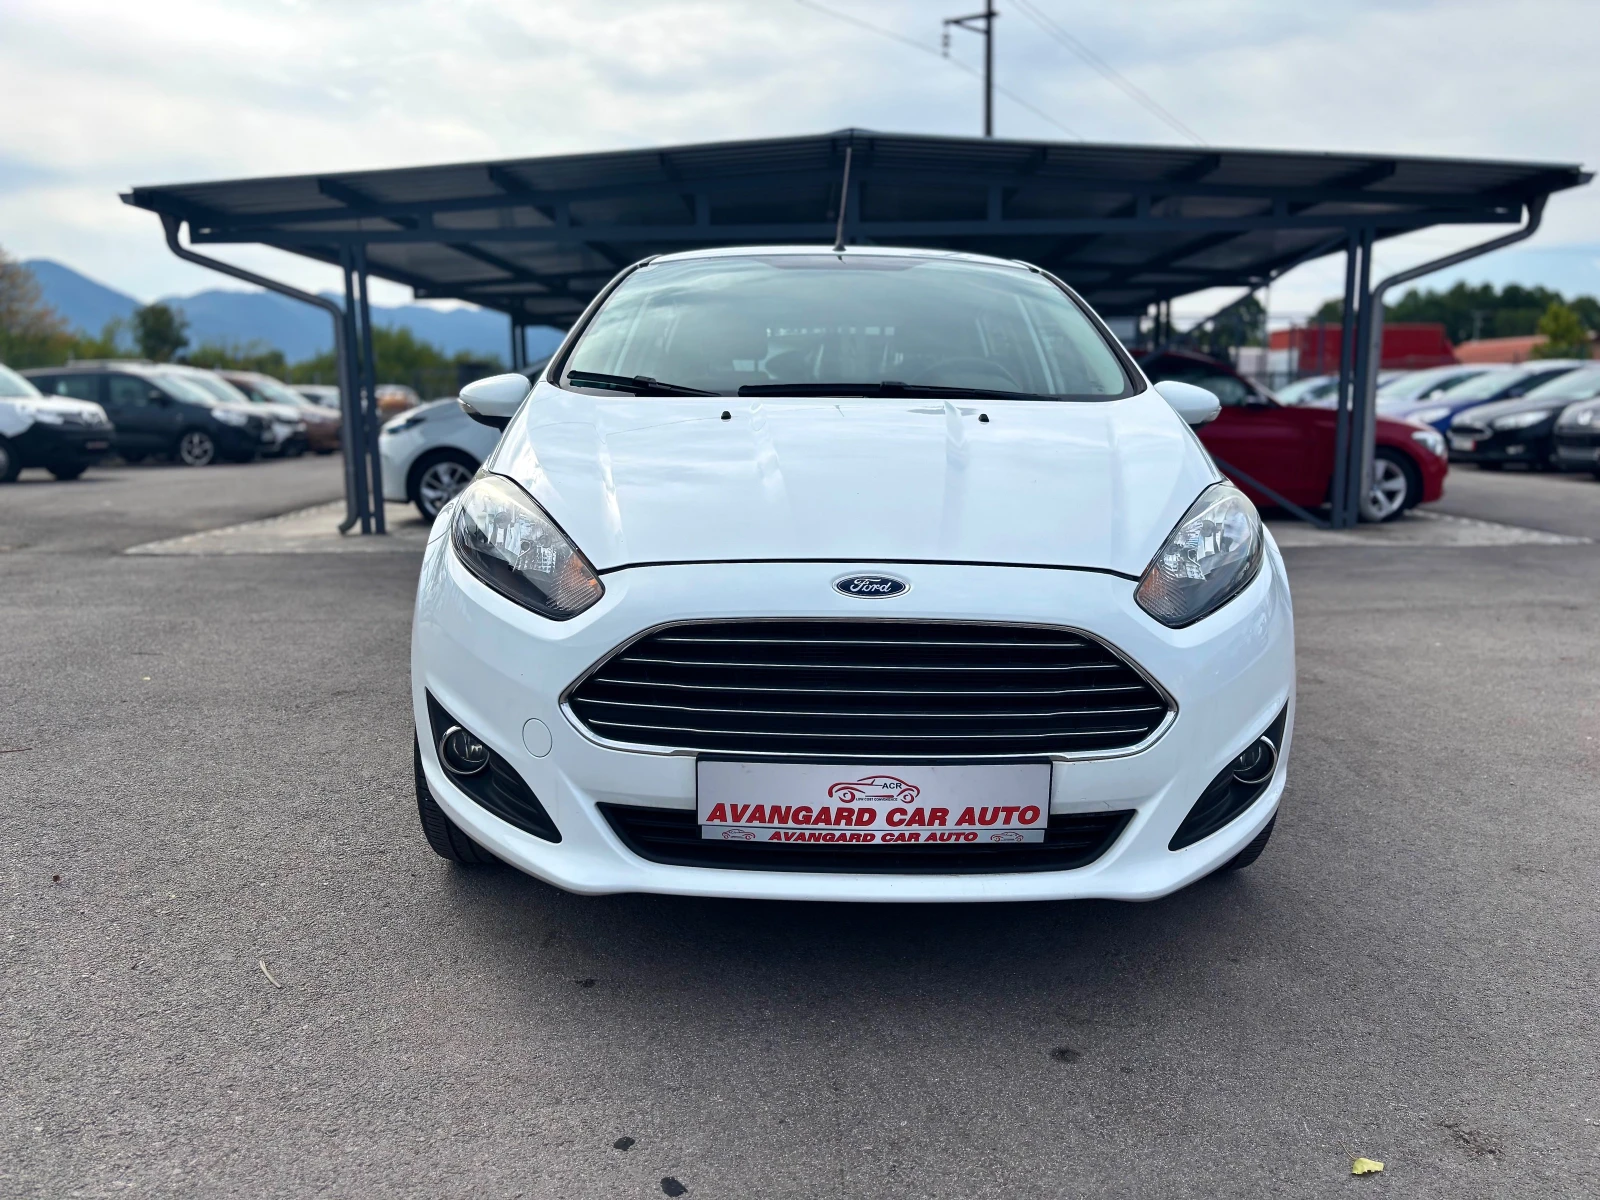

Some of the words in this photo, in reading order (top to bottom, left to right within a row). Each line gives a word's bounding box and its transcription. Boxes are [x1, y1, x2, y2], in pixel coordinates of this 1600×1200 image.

[850, 579, 892, 592] Ford
[706, 803, 877, 827] AVANGARD
[885, 807, 949, 827] CAR
[955, 805, 1041, 826] AUTO
[768, 831, 876, 843] AVANGARD
[880, 832, 921, 843] CAR
[924, 832, 978, 842] AUTO
